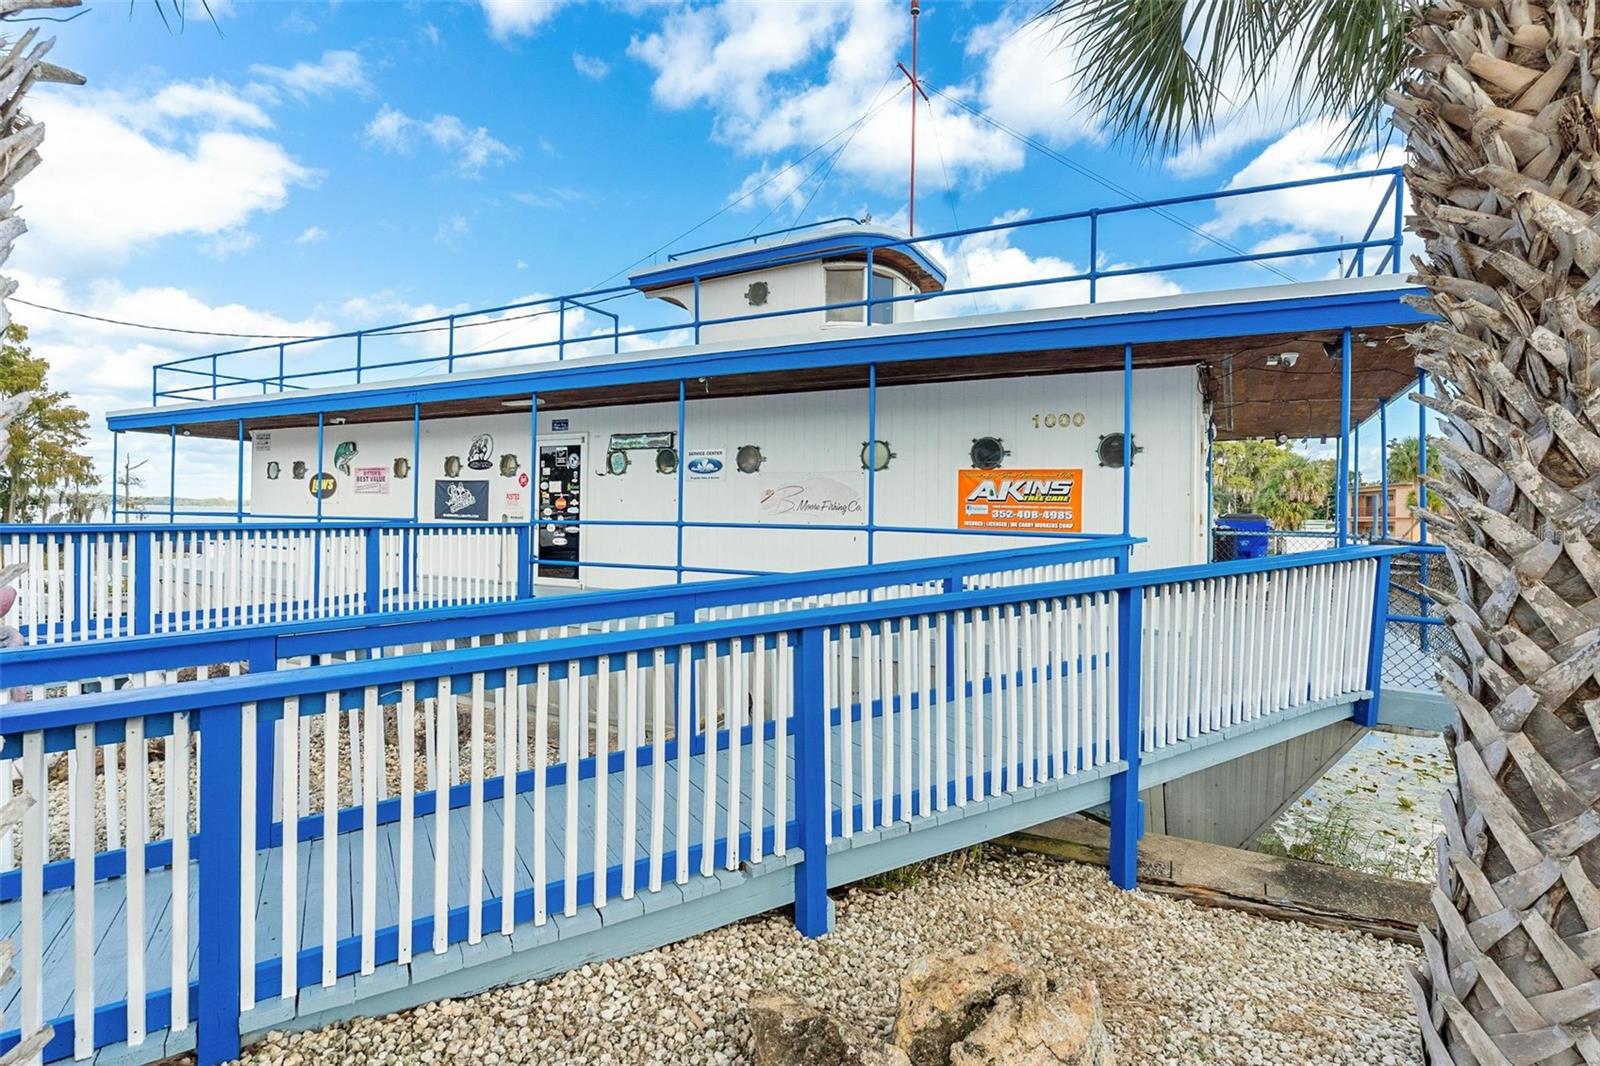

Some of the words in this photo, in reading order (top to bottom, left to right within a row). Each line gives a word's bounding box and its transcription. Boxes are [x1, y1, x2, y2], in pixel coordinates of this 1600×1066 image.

[1032, 412, 1085, 428] 1000
[966, 480, 1074, 503] AKINS
[821, 500, 847, 515] Fishing
[848, 499, 863, 512] Co.
[992, 509, 1073, 520] 352-408-4985
